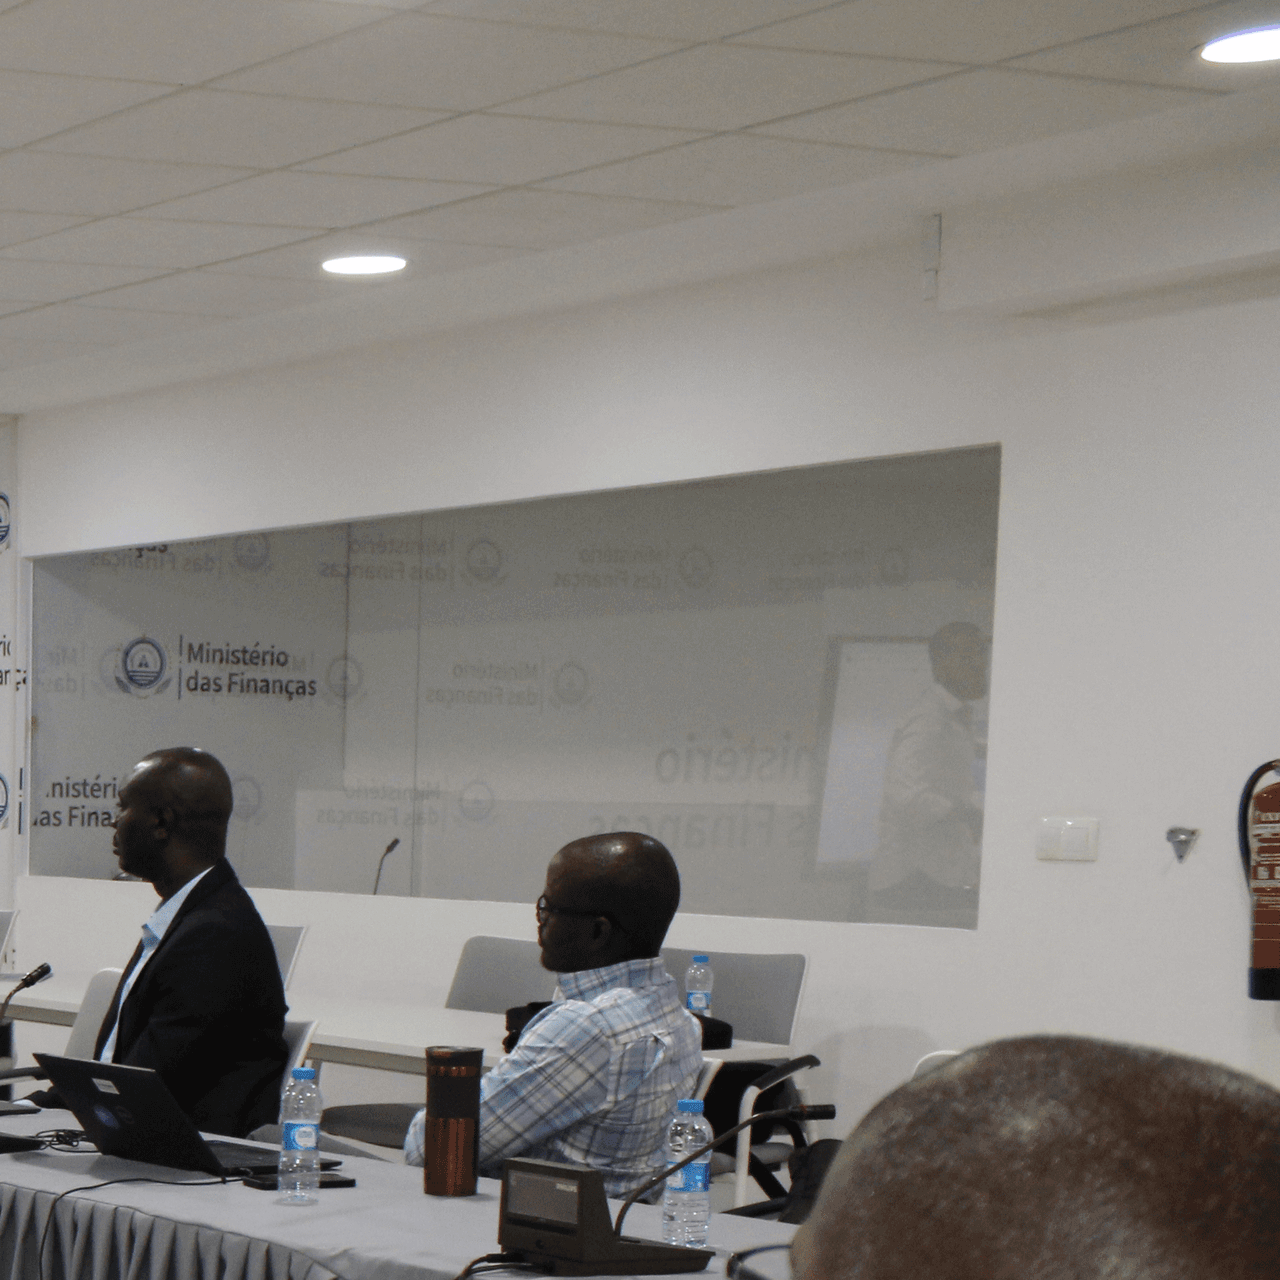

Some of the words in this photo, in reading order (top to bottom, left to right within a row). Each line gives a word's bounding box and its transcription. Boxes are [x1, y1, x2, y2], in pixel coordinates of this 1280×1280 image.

[187, 641, 289, 667] Ministério
[186, 670, 223, 692] das
[228, 672, 317, 701] Finanças
[34, 808, 62, 827] as
